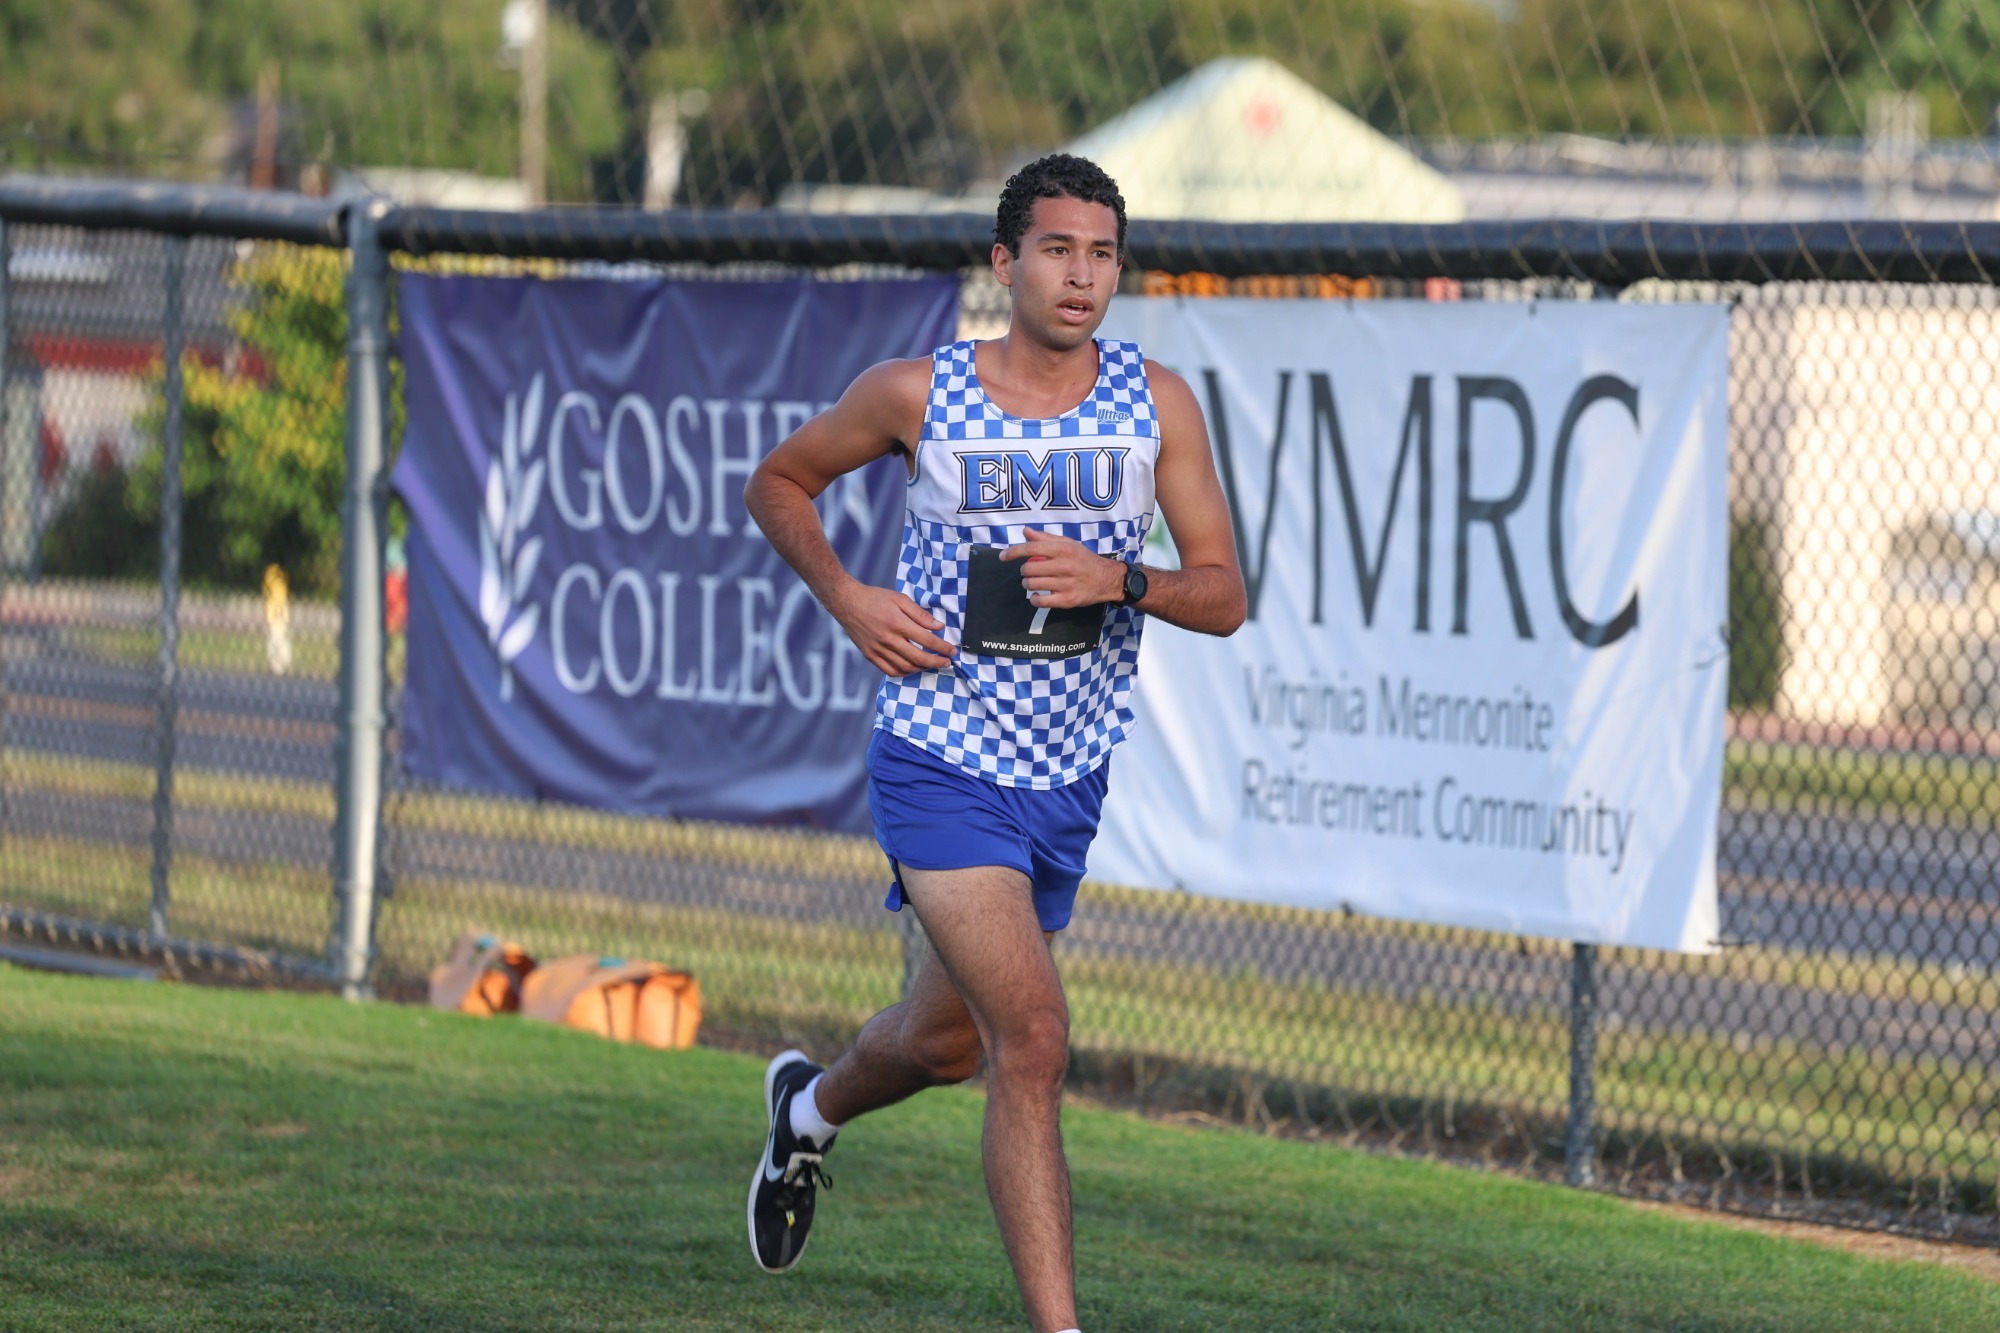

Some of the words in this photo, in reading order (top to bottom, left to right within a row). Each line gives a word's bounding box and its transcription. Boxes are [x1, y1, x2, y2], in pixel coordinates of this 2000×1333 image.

[953, 447, 1131, 514] EMU
[1202, 367, 1641, 649] VMRC
[550, 563, 870, 711] COLLEGE
[982, 640, 1086, 654] www.snaptiming.com
[1243, 665, 1368, 750] Virginia
[1376, 674, 1554, 753] Mennonite
[1241, 757, 1426, 840] Retirement
[1433, 777, 1635, 874] Community
